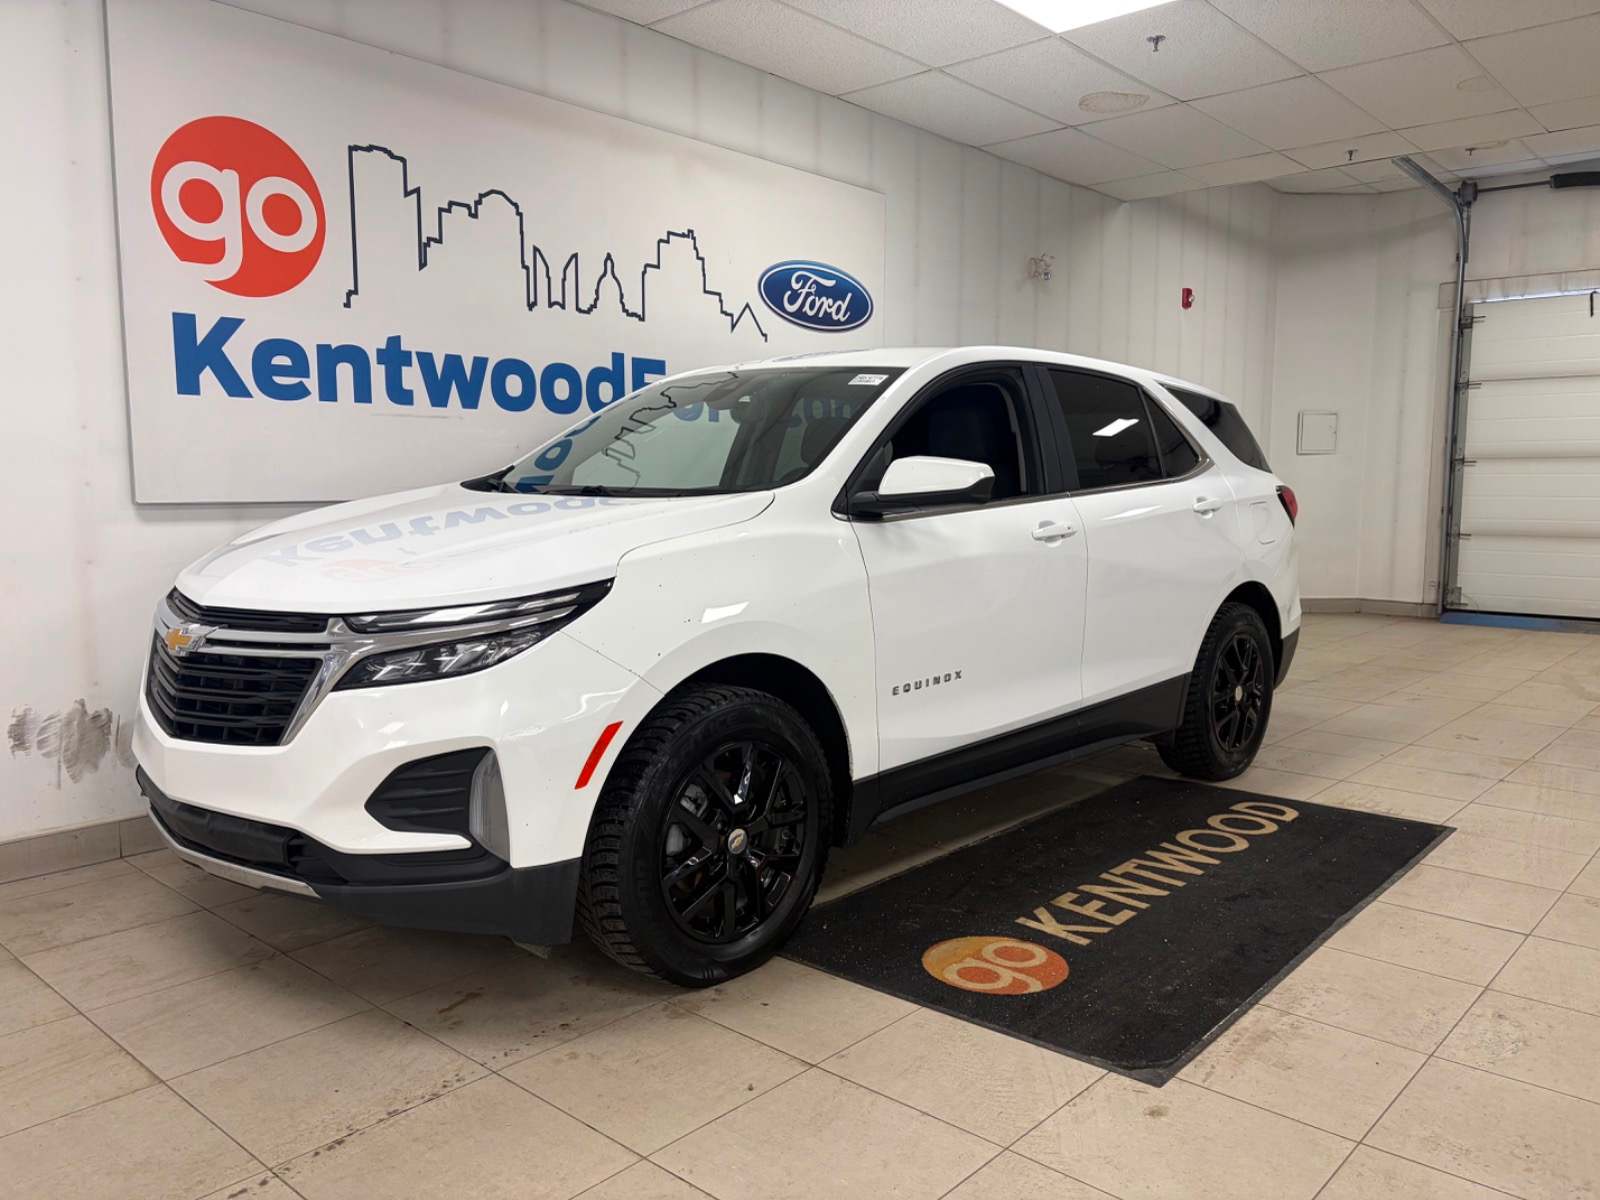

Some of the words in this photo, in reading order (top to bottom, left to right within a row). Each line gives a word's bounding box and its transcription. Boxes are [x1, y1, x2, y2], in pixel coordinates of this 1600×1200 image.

[161, 161, 318, 281] go
[783, 270, 853, 322] Ford
[892, 669, 962, 696] EQUINOX
[943, 941, 1047, 993] go
[1015, 801, 1299, 946] KENTWOOD
